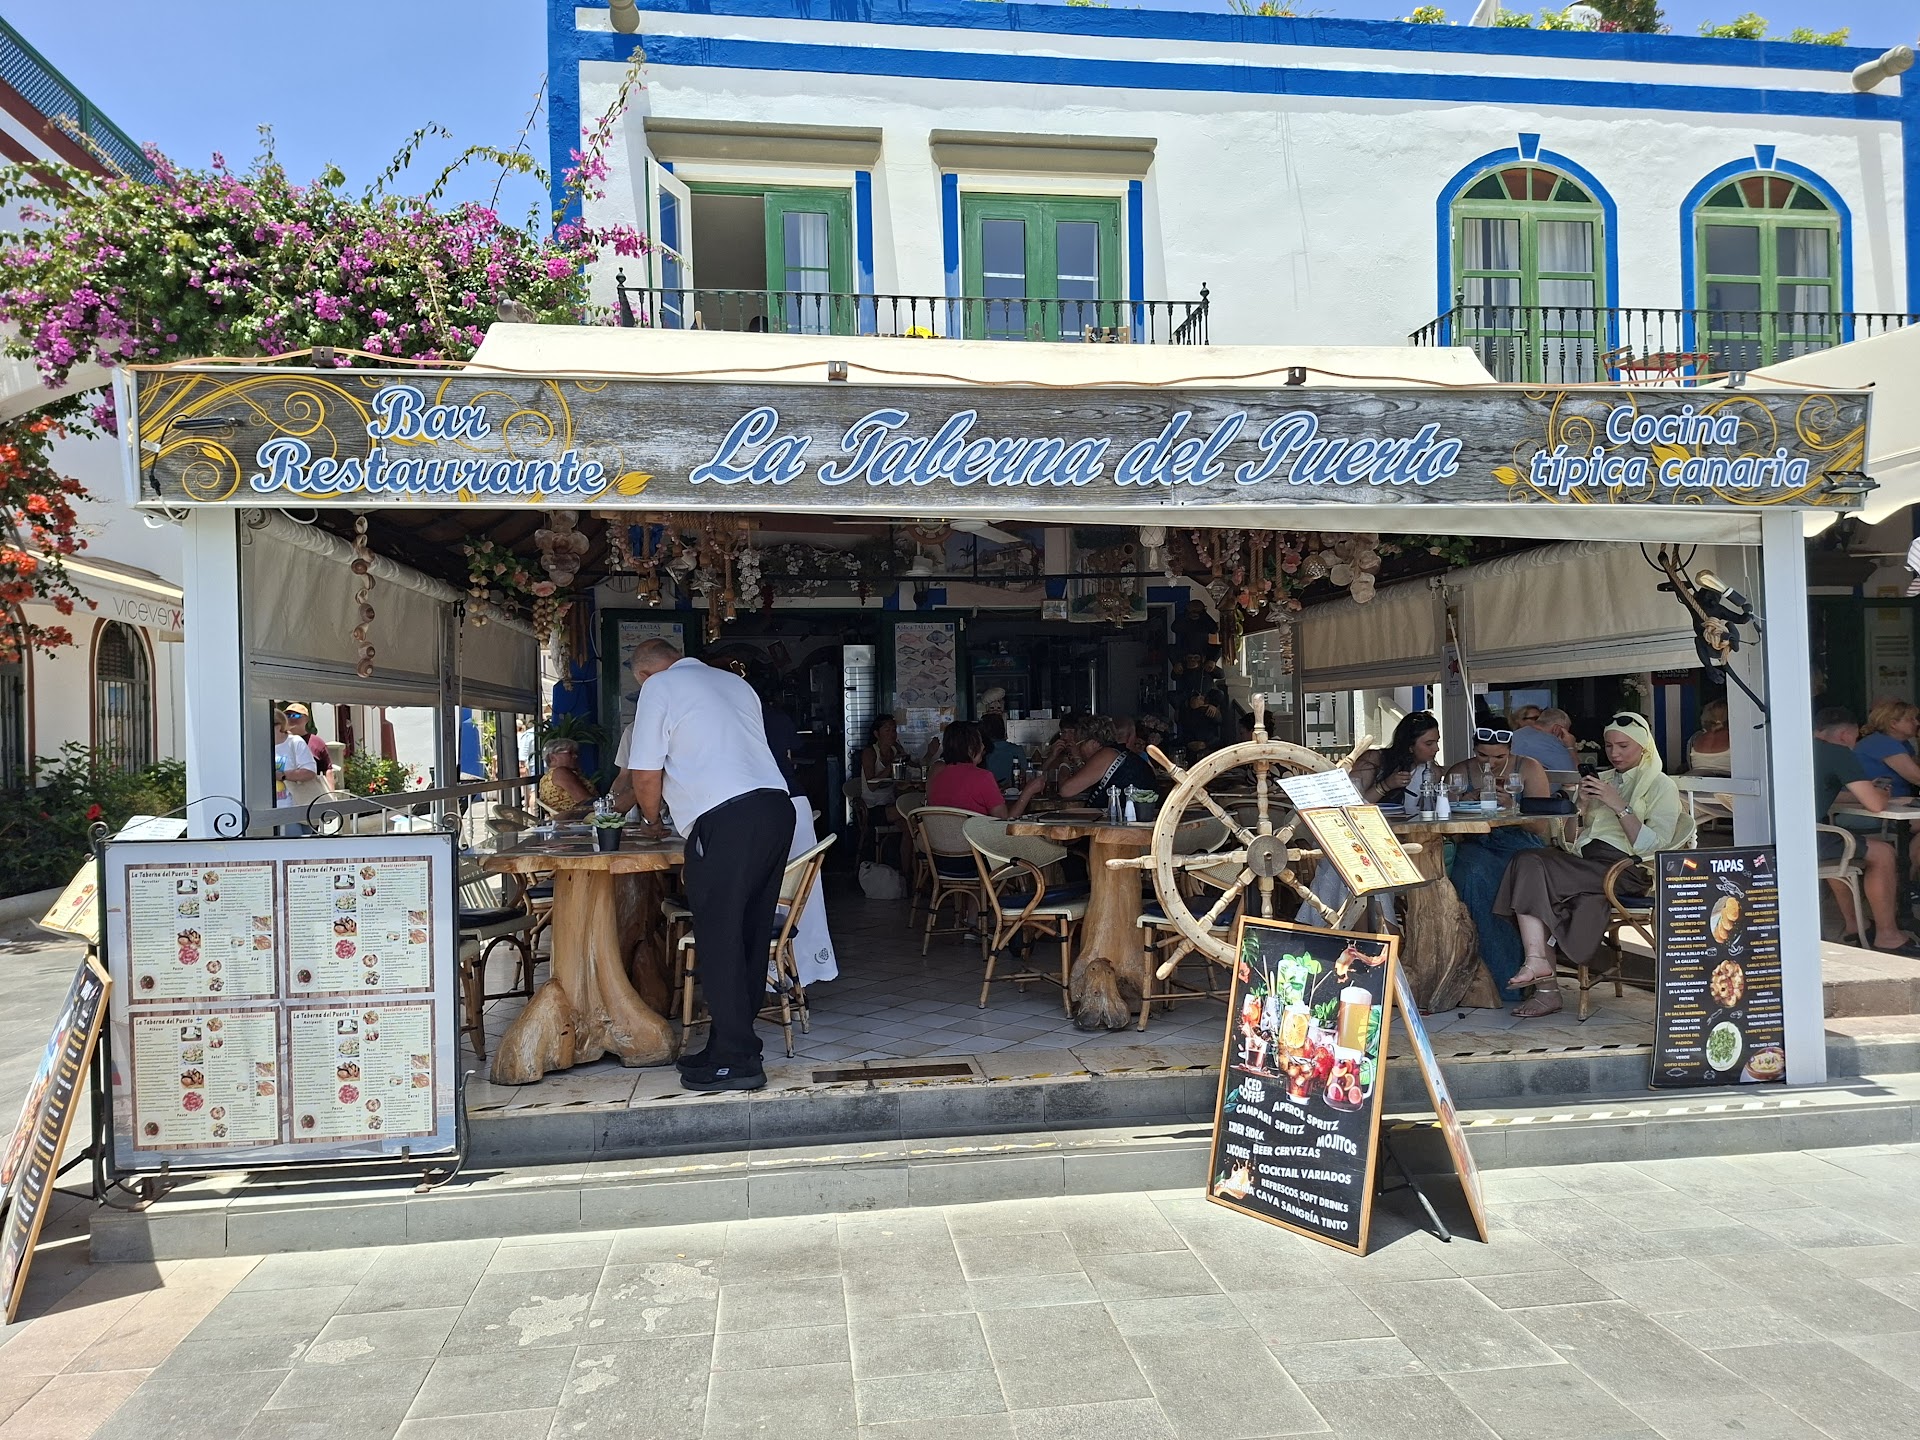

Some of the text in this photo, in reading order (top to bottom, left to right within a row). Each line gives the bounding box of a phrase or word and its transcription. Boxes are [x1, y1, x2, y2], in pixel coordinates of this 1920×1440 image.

[366, 384, 490, 441] Bar
[1605, 404, 1740, 446] Cocina
[689, 406, 1462, 487] La Taberna del Puerto
[249, 437, 606, 495] Restaurante
[1530, 445, 1809, 495] típica canaria
[1710, 859, 1744, 873] TAPAS
[1238, 1084, 1265, 1103] COFFEE
[1244, 1076, 1262, 1092] ICED
[1236, 1104, 1305, 1135] CAMPARI SPRITZ
[1272, 1101, 1339, 1131] APEROL SPRITZ
[1253, 1143, 1320, 1158] BEER CERVEZAS
[1316, 1133, 1357, 1156] MOJITOS
[1258, 1163, 1351, 1185] COCKTAIL VARIADOS
[1256, 1189, 1280, 1207] CAVA
[1281, 1200, 1319, 1225] SANGRÍA
[1321, 1217, 1348, 1231] TINTO
[1261, 1178, 1349, 1213] REFRESCOS SOFT DRINKS
